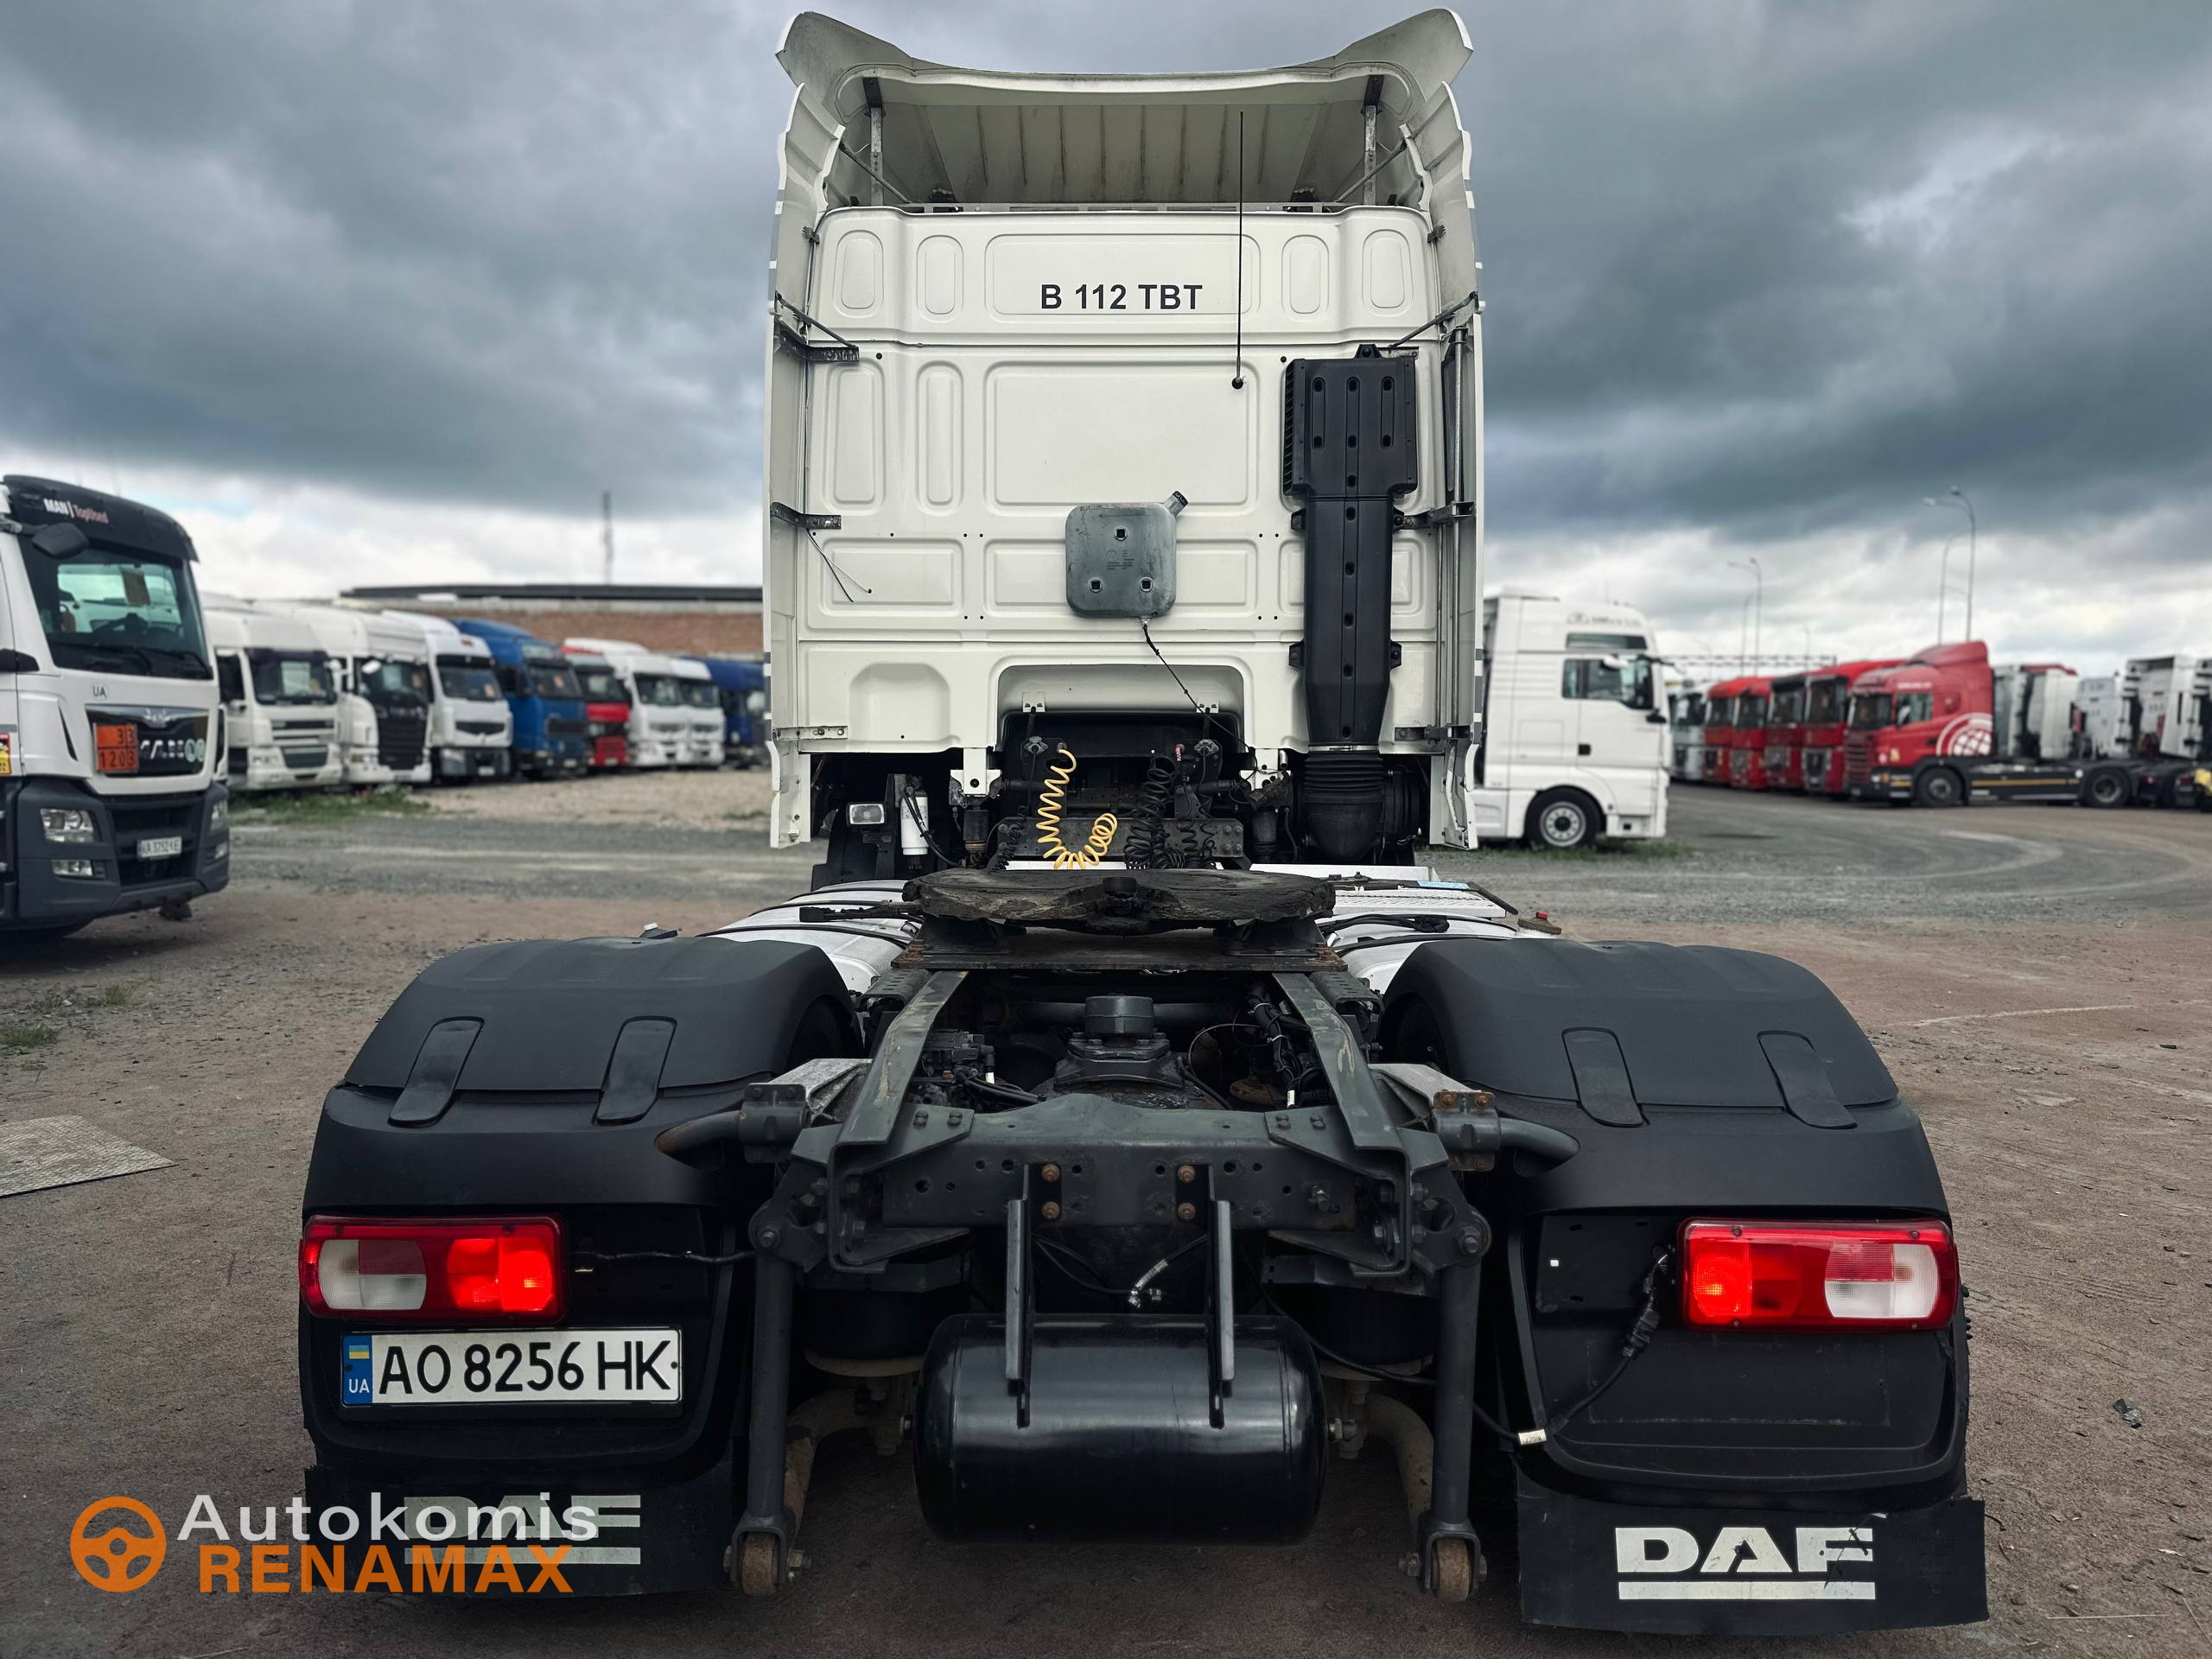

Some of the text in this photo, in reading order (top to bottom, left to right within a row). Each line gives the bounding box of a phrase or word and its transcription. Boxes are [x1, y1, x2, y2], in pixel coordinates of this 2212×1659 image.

[1041, 284, 1203, 309] B 112 TBT
[43, 499, 69, 515] MAN
[92, 686, 107, 697] UA
[118, 728, 136, 747] 33
[99, 750, 137, 769] 1203
[378, 1341, 671, 1394] AO 8256 HK
[349, 1378, 370, 1393] UA
[1616, 1528, 1873, 1573] DAF
